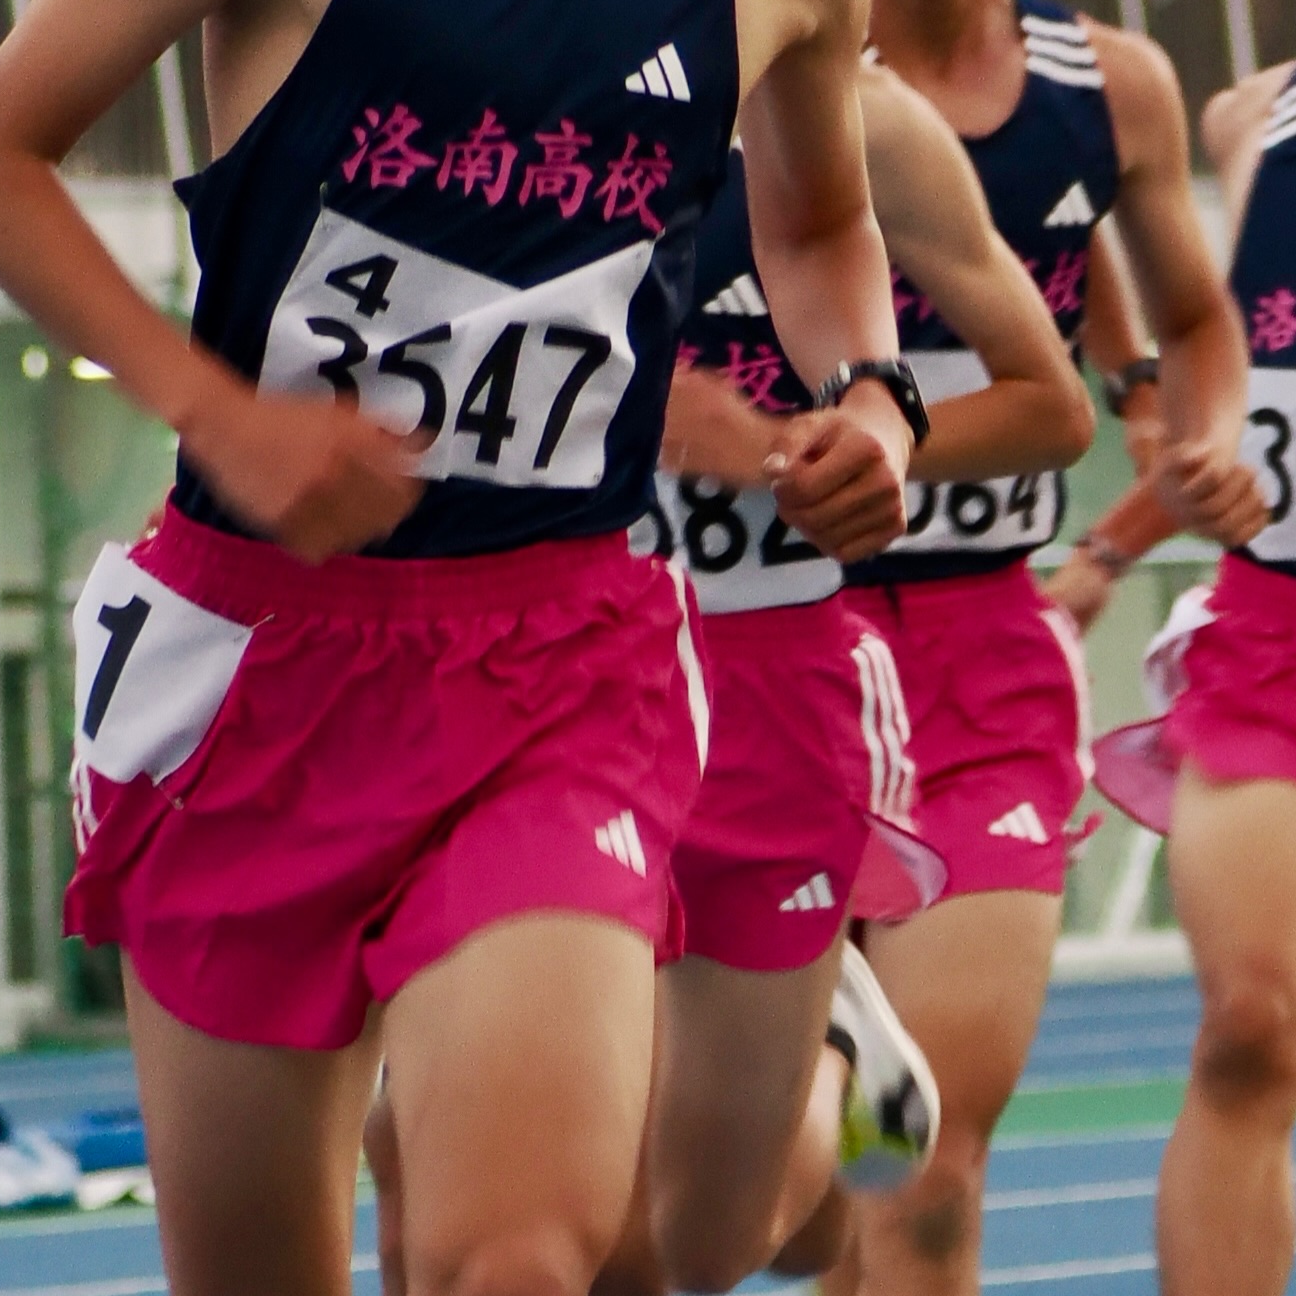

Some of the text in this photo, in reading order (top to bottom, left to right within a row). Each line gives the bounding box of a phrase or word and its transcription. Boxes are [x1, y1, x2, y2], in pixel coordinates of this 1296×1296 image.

[341, 104, 673, 234] 洛南高校
[325, 253, 399, 319] 4
[305, 316, 612, 470] 3547
[82, 594, 152, 742] 1
